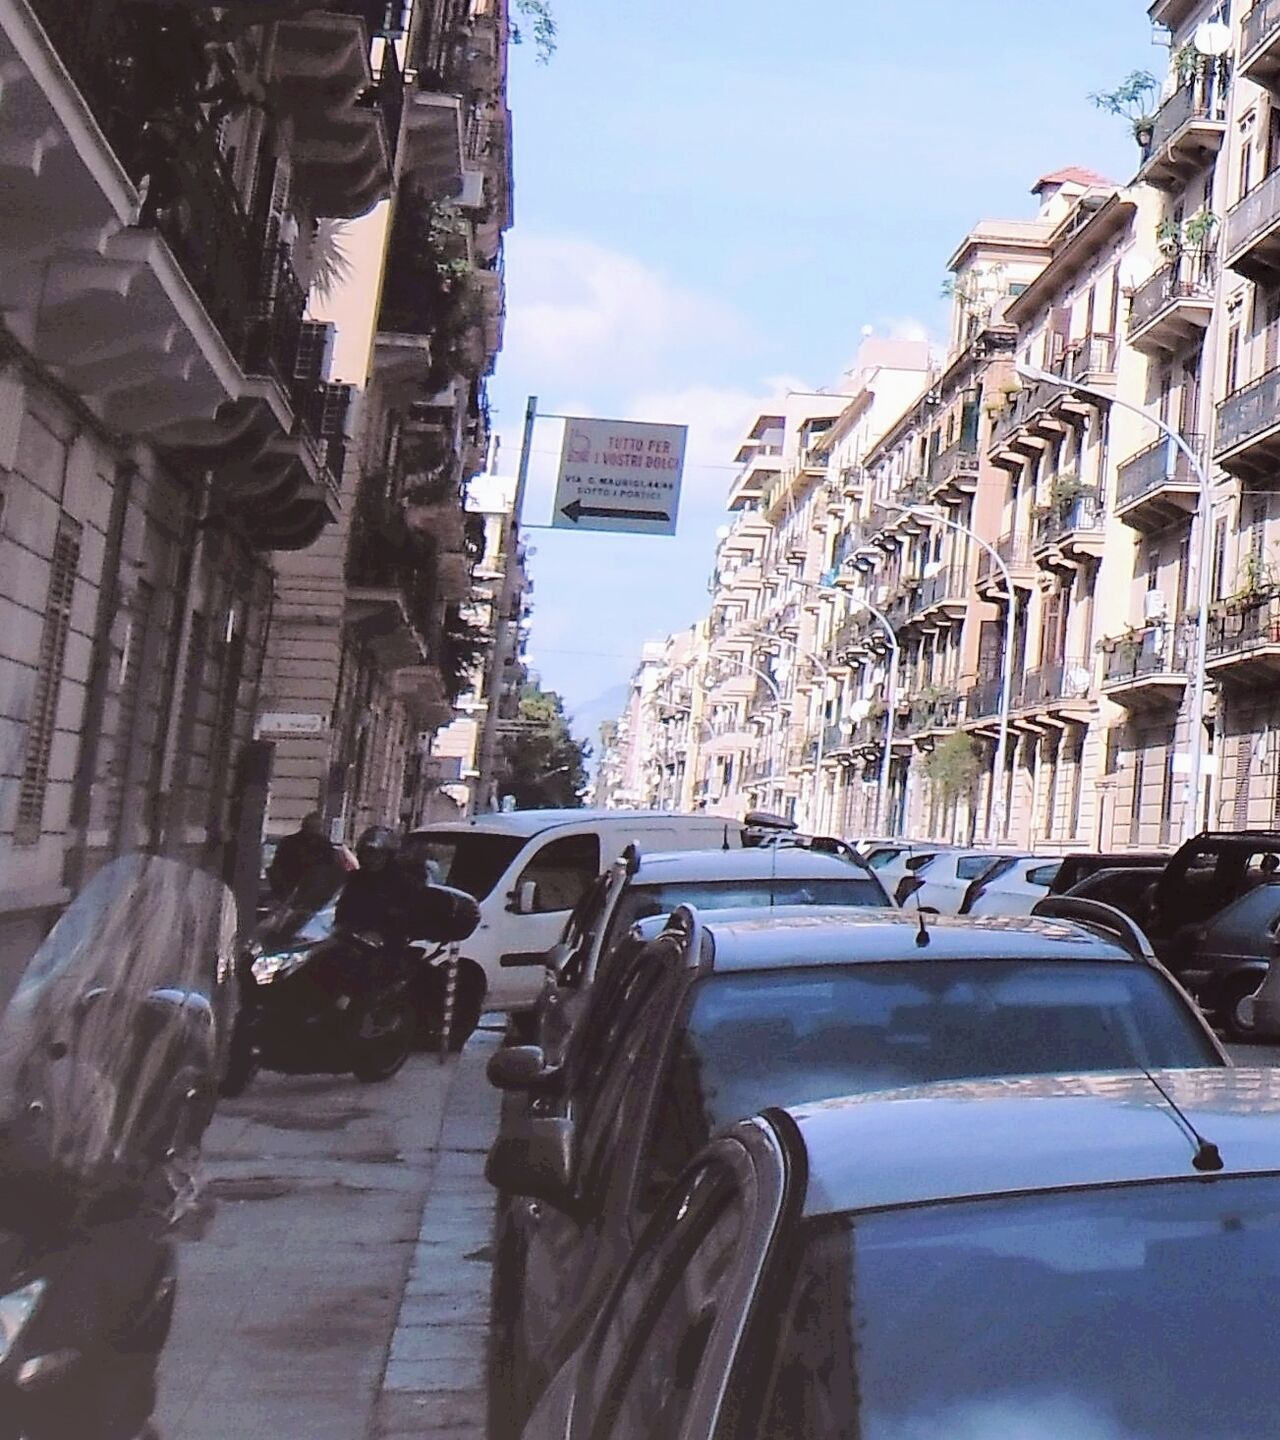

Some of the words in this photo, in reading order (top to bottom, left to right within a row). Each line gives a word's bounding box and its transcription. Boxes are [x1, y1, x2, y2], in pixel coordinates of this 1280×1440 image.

[609, 437, 643, 450] TUTTO
[648, 439, 671, 454] PER
[603, 453, 643, 467] VOSTRI
